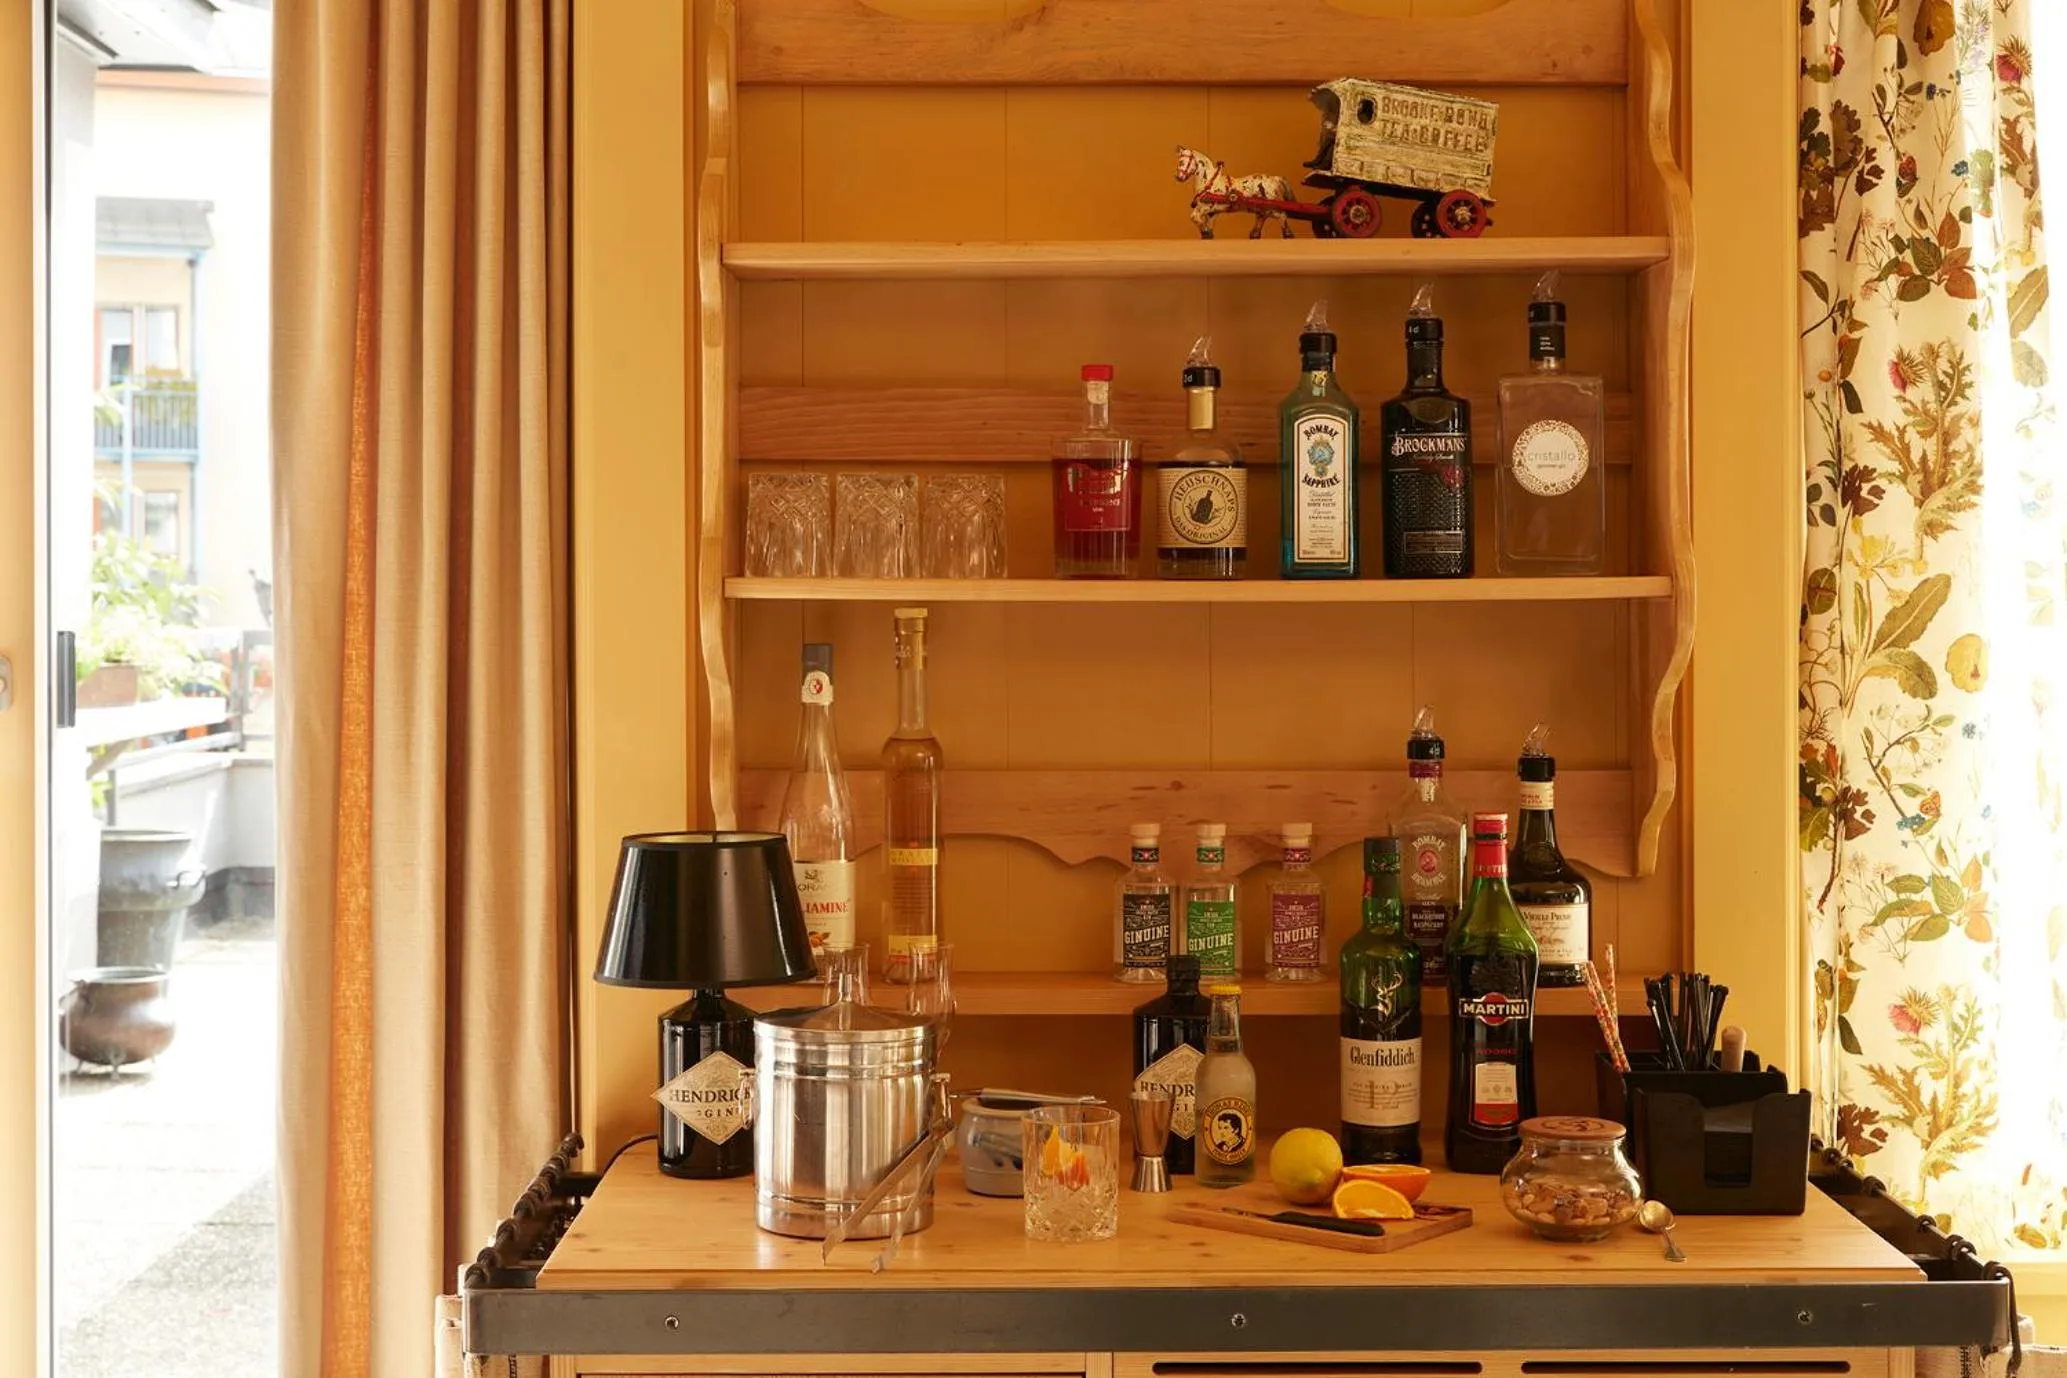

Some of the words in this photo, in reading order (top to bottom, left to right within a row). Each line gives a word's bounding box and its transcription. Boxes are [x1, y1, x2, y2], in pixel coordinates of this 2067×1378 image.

[1381, 96, 1439, 122] BROOKE
[1303, 424, 1339, 440] BOMBAY
[1391, 434, 1466, 456] BROCKMANS
[1527, 449, 1576, 461] cristallo
[1302, 472, 1340, 488] SAPPHIRE
[1174, 475, 1235, 513] HEUSCHNAPS
[1124, 925, 1170, 945] GINUINE
[1188, 932, 1234, 951] GINUINE
[1273, 926, 1320, 945] GINUINE
[1463, 1003, 1525, 1015] MARTINI
[1350, 1045, 1415, 1067] Glenfiddich
[1140, 1081, 1195, 1097] HENDR
[705, 1108, 734, 1118] GIN
